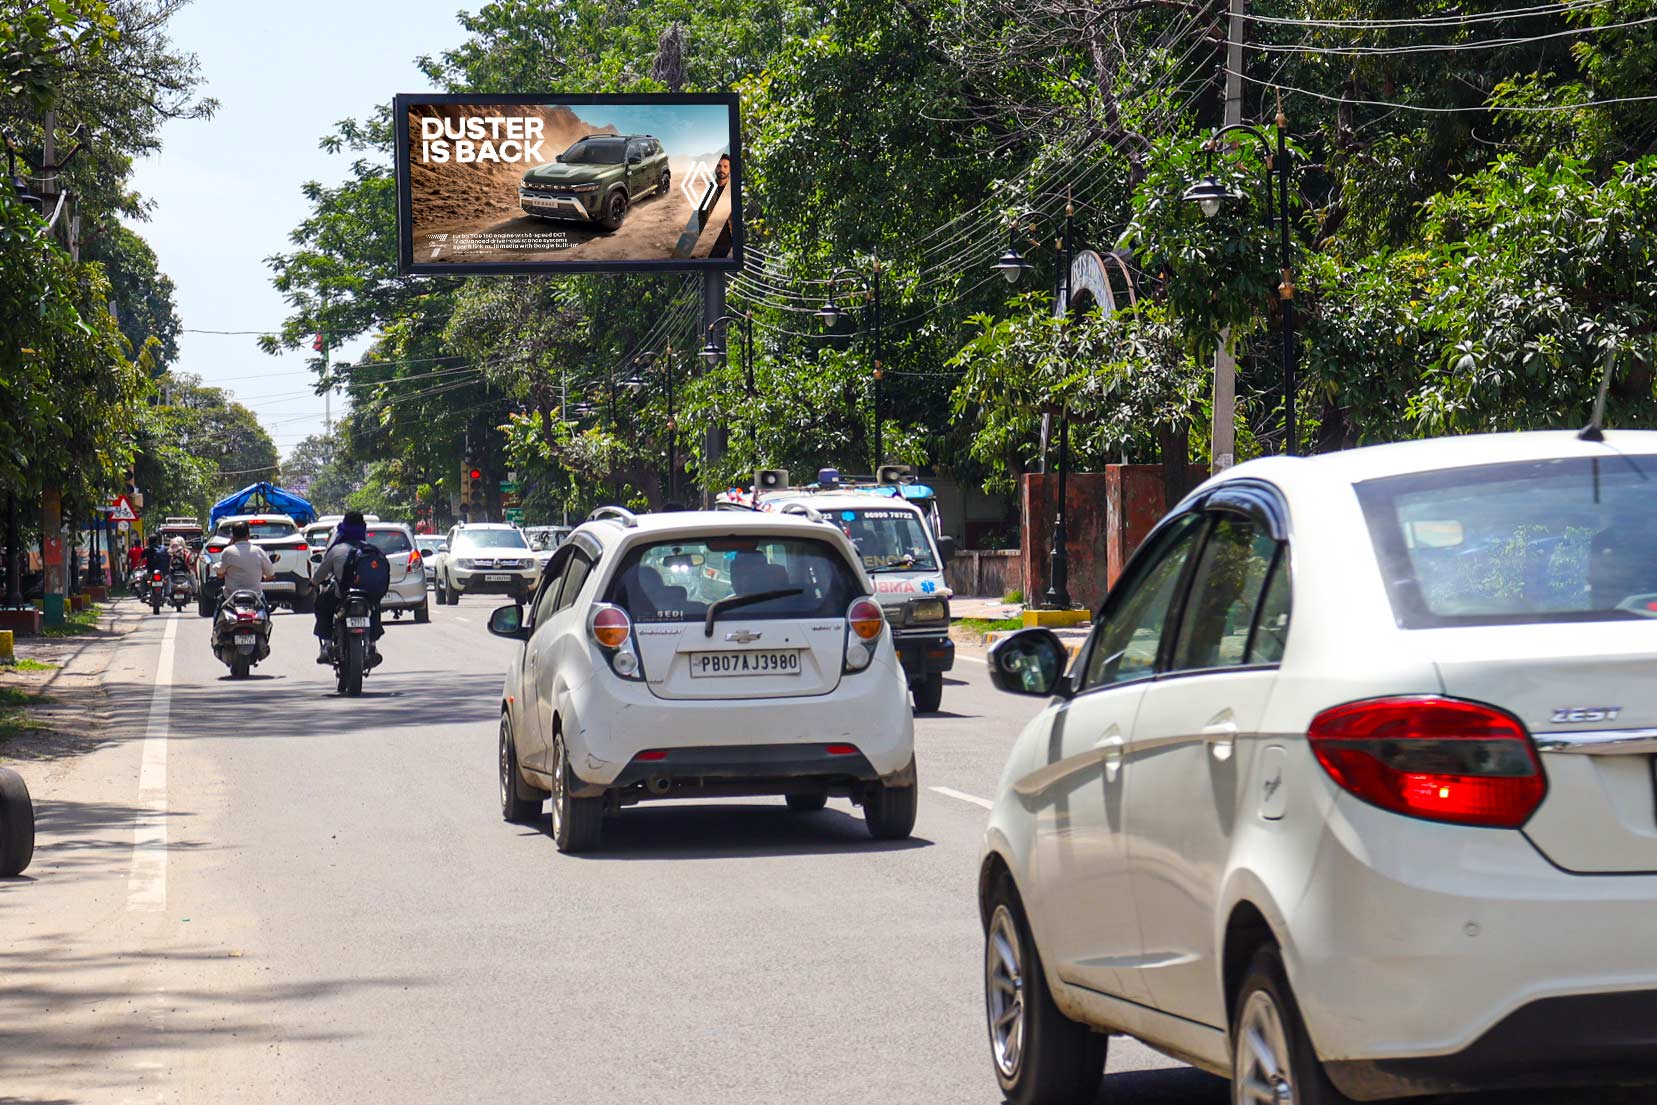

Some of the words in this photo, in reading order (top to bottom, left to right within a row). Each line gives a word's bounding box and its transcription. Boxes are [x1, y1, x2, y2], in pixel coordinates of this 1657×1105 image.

[421, 116, 545, 140] DUSTER
[422, 140, 450, 163] IS
[456, 140, 546, 164] BACK
[701, 653, 798, 673] PB07AJ3980
[1548, 706, 1624, 724] ZEST
